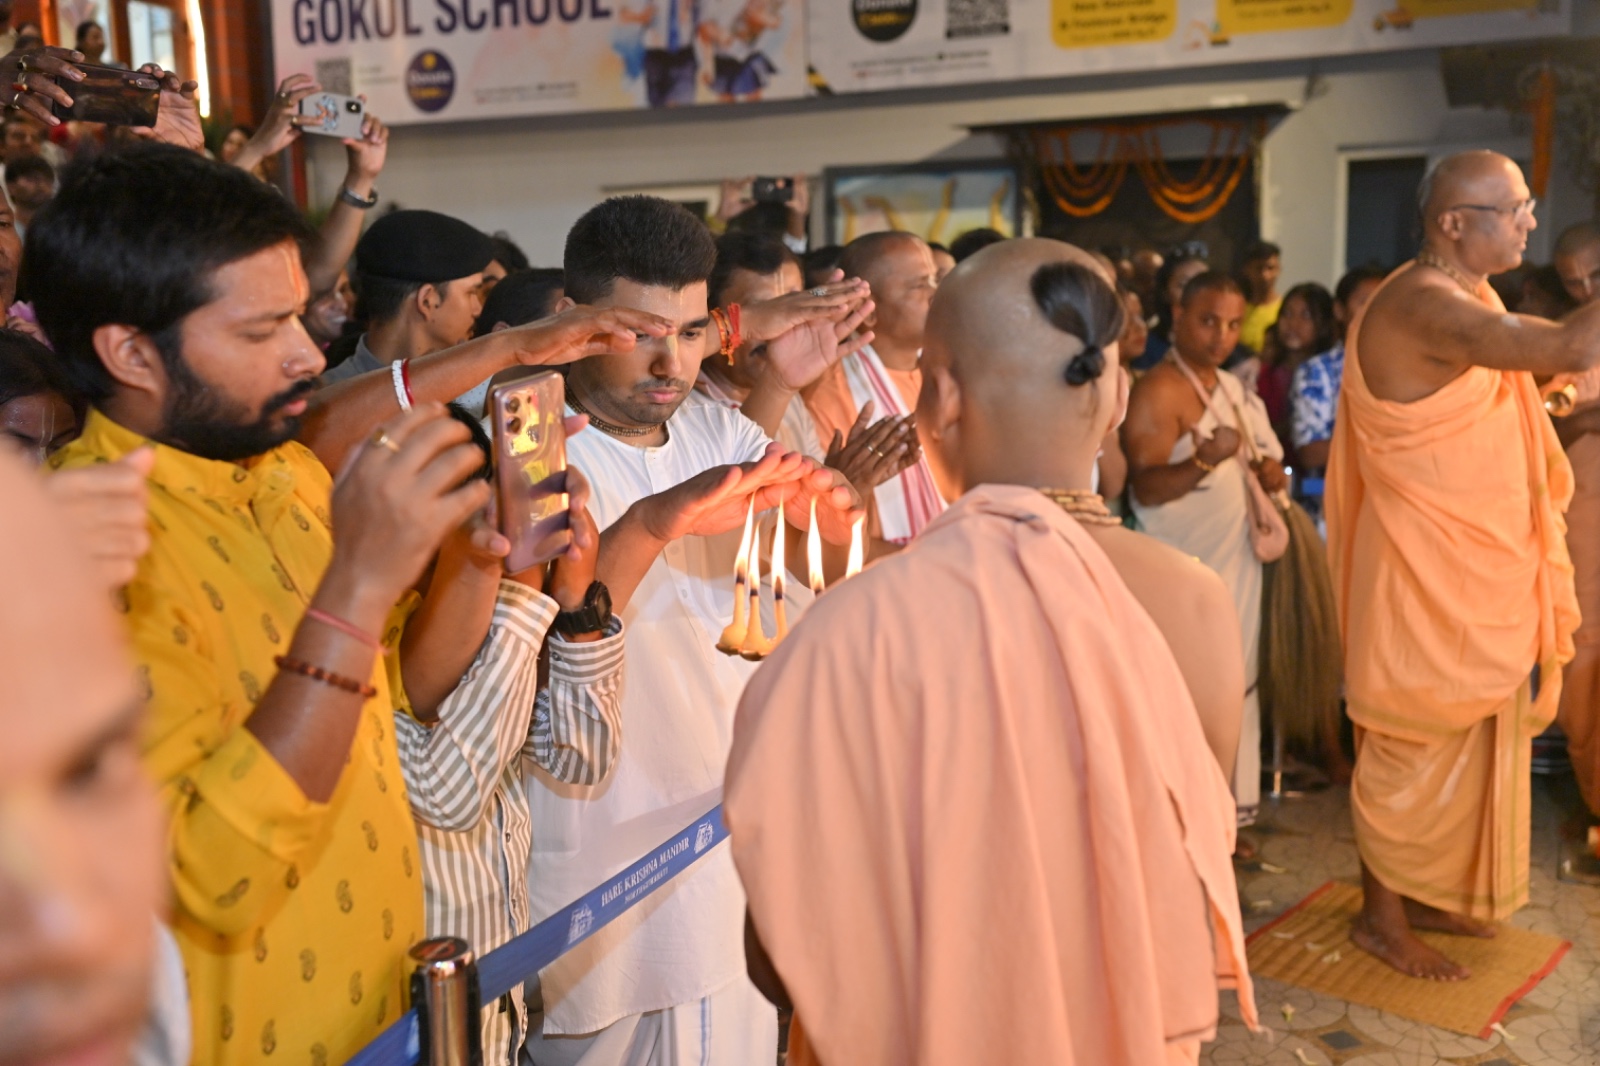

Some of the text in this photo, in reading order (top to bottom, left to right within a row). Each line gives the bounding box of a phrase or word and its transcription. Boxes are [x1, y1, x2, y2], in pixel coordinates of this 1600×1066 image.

[293, 0, 422, 45] GOKUL
[601, 837, 689, 907] HARE KRISHNA MANDIR
